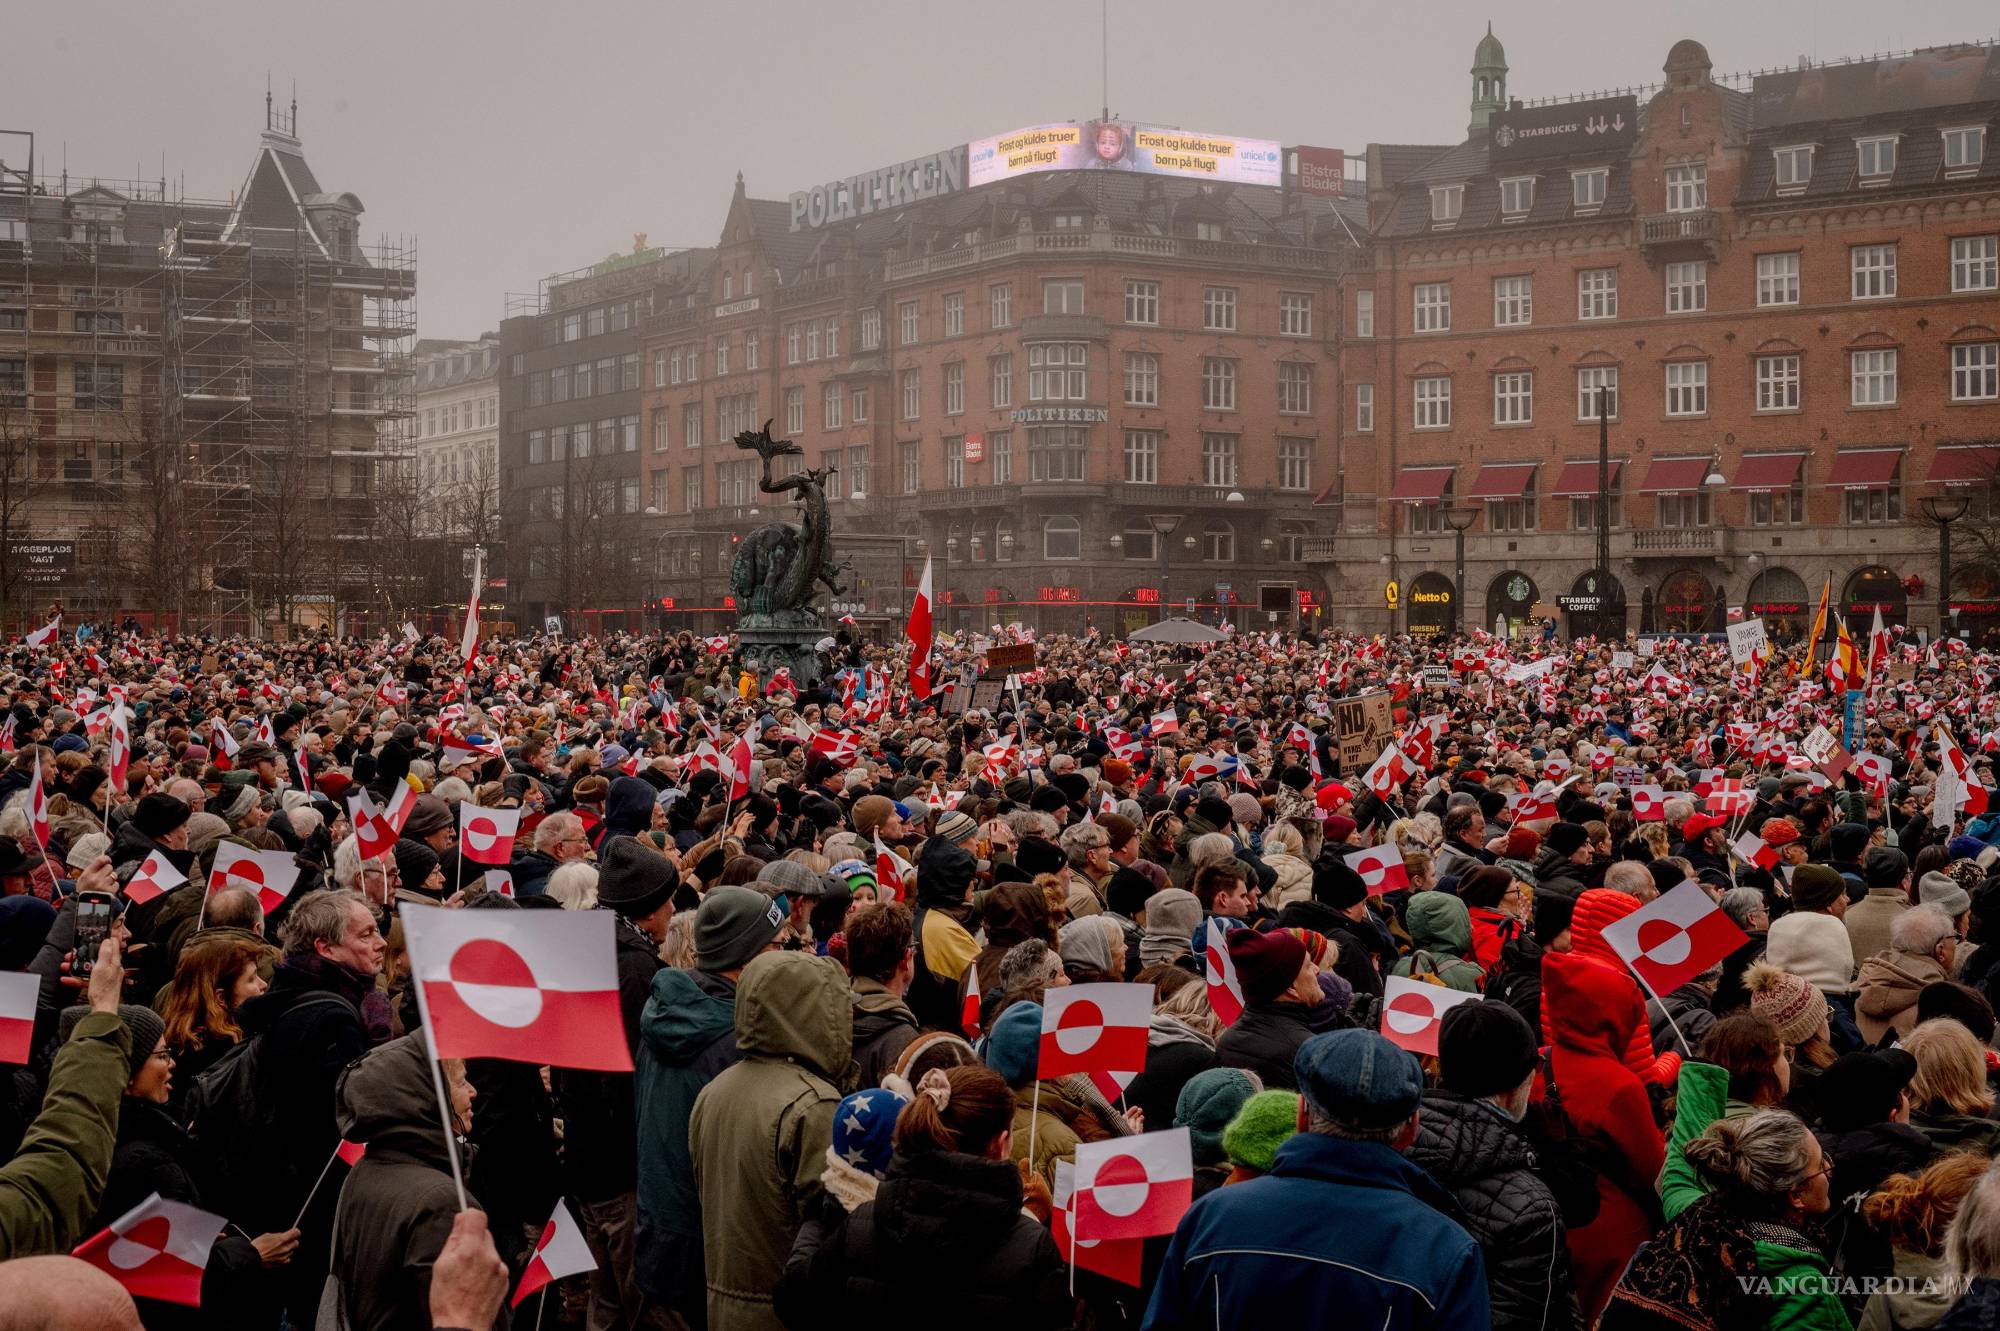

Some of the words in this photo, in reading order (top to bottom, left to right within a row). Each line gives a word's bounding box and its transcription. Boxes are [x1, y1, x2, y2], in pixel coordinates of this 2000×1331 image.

[1519, 123, 1577, 138] STARBUCKS
[999, 140, 1015, 153] Frost
[1015, 138, 1023, 150] og
[1024, 134, 1047, 147] kulde
[1048, 132, 1075, 142] truer
[1139, 135, 1165, 147] Frost
[1166, 139, 1178, 150] og
[1180, 139, 1207, 152] kulde
[1208, 143, 1231, 154] truer
[1008, 155, 1022, 168] børn
[1023, 152, 1033, 166] på
[1034, 150, 1057, 163] flugt
[1155, 154, 1178, 166] børn
[1179, 157, 1192, 168] på
[1193, 158, 1216, 172] flugt
[1241, 151, 1266, 161] unicef
[1302, 162, 1342, 178] Ekstra
[789, 145, 967, 233] POLITIKEN
[1302, 176, 1343, 192] Bladet
[1010, 407, 1109, 423] POLITIKEN
[1415, 593, 1440, 602] Netto
[1737, 643, 1747, 656] GO
[1339, 702, 1365, 736] NO
[1343, 745, 1362, 754] HANDS
